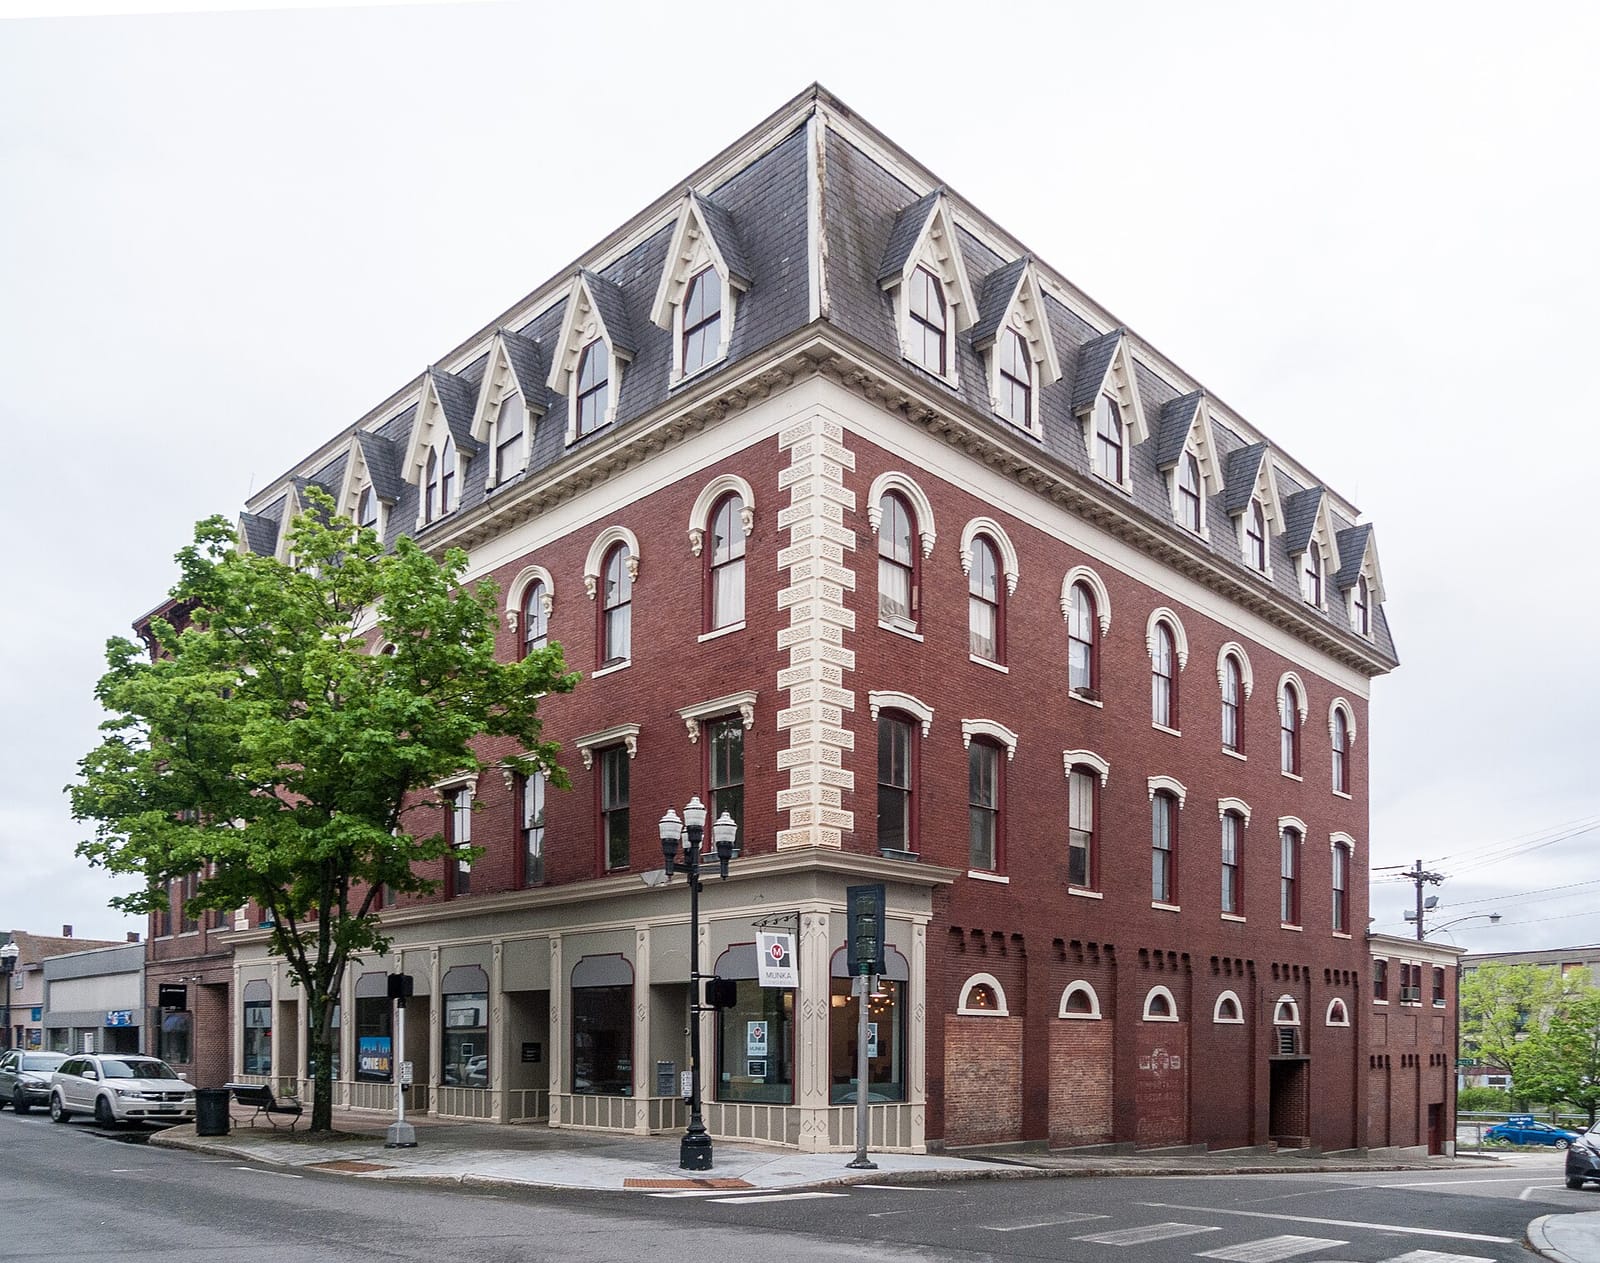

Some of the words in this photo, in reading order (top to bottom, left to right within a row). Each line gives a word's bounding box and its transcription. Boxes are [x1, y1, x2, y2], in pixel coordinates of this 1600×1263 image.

[773, 947, 781, 956] M
[766, 971, 792, 979] MUNKA
[362, 1057, 379, 1070] ONE
